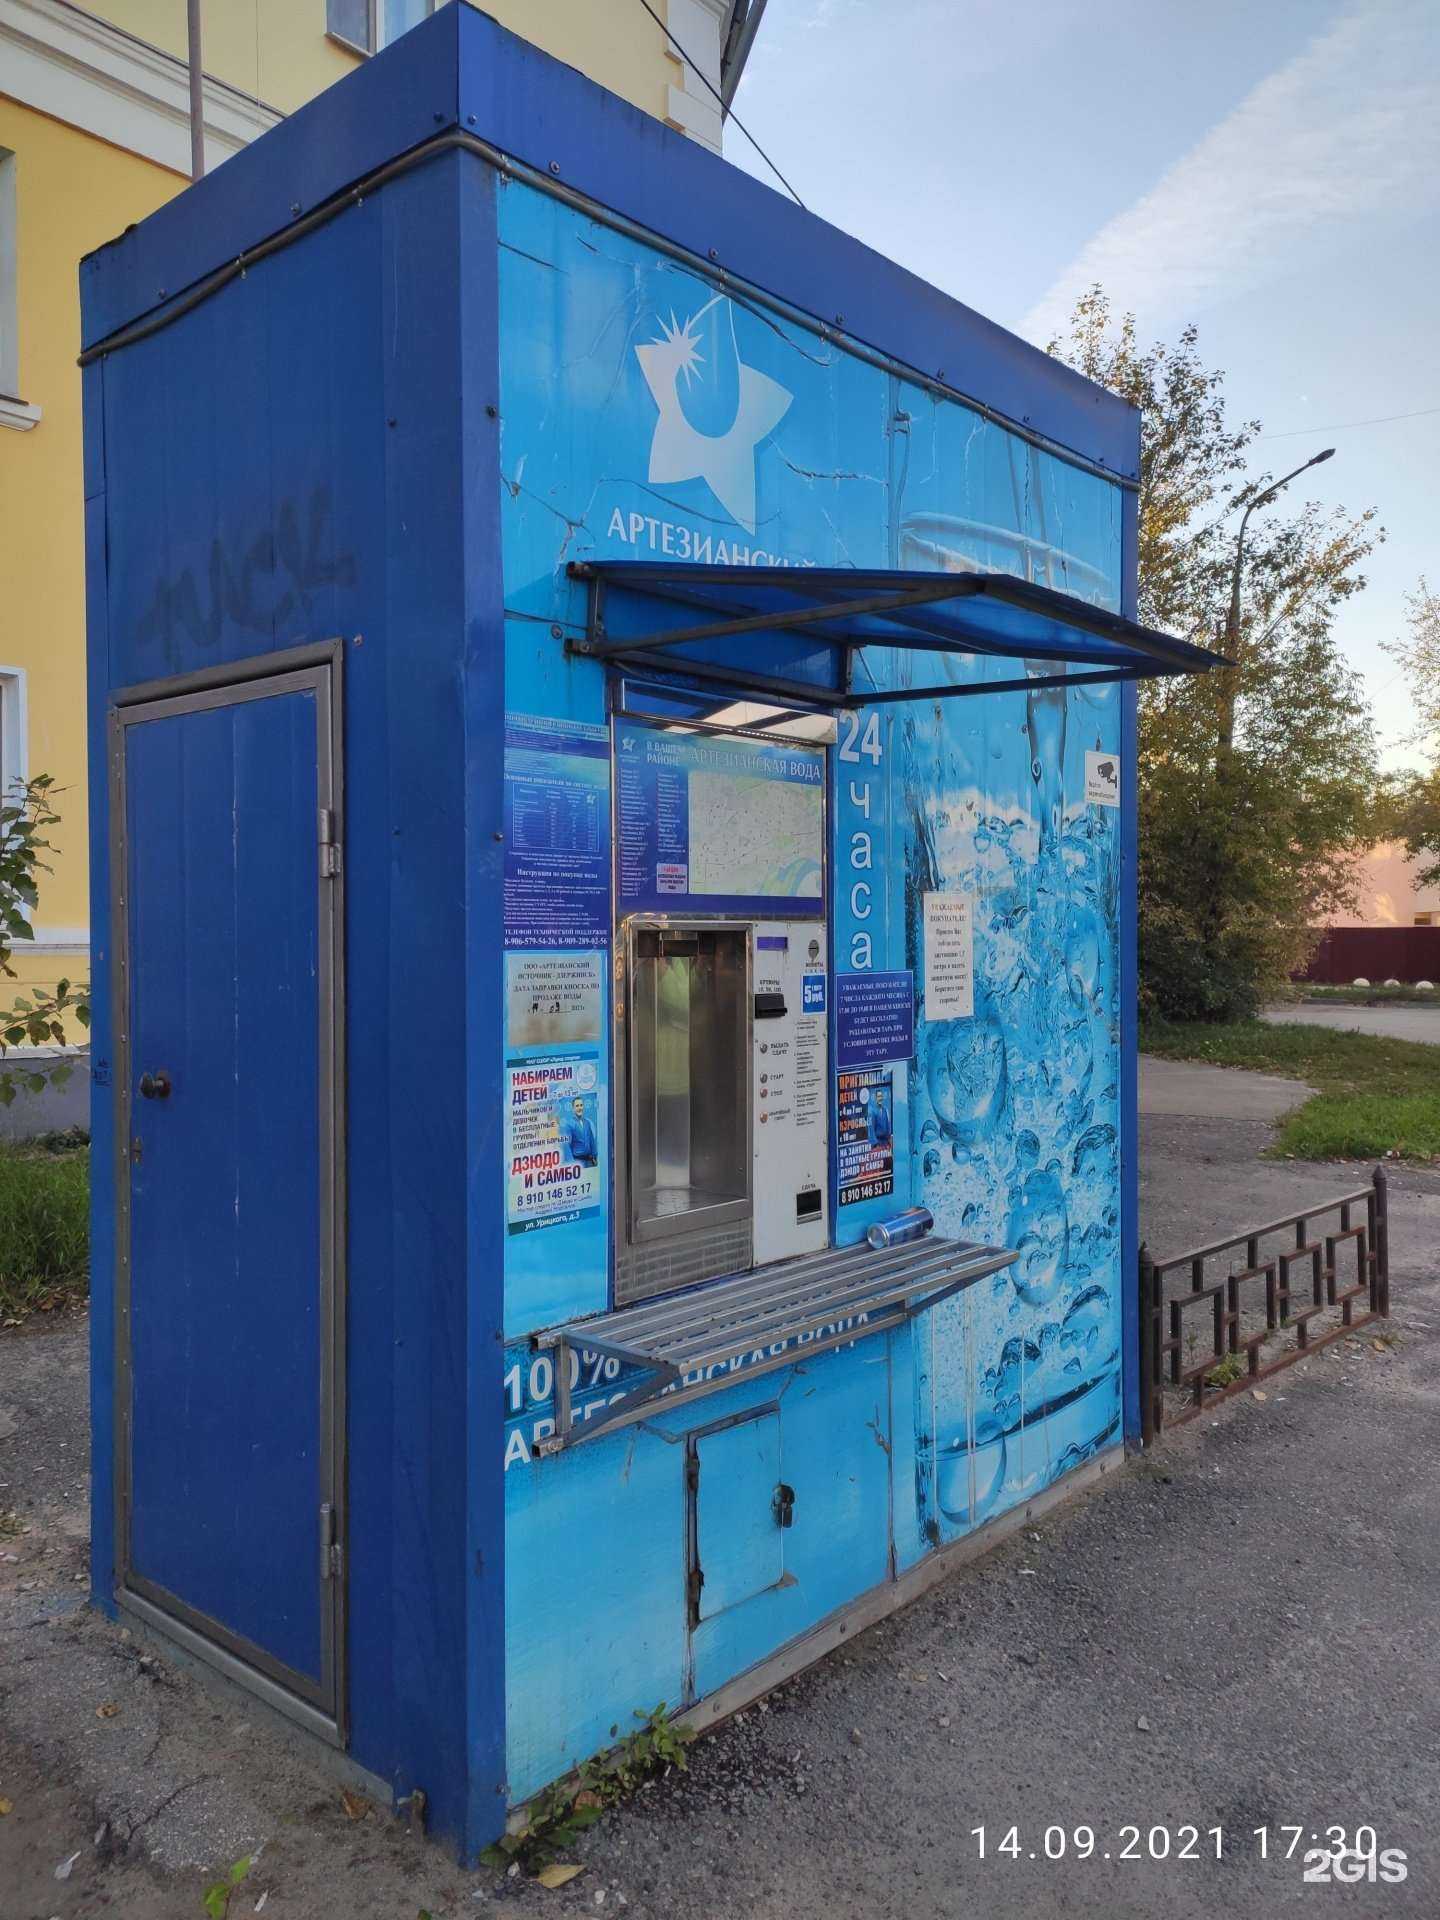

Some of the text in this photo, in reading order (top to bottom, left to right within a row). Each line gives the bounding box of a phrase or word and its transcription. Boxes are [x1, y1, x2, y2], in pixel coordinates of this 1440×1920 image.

[607, 506, 816, 568] АРТЕЗИАНС
[838, 709, 883, 766] 24
[790, 761, 820, 779] ВОДА
[512, 1067, 572, 1086] НАБИРАЕМ
[840, 1072, 885, 1089] ПРИГЛАША
[512, 1087, 548, 1105] ДЕТЕЙ
[840, 1147, 848, 1157] НА
[512, 1151, 560, 1176] ДЗЮДО
[840, 1166, 860, 1178] ДЗЮДО
[865, 1160, 884, 1171] САМБО
[525, 1165, 581, 1188] И САМБО
[517, 1183, 591, 1206] 8 910 146 52 17
[841, 1180, 891, 1203] 8 910 146 52 17
